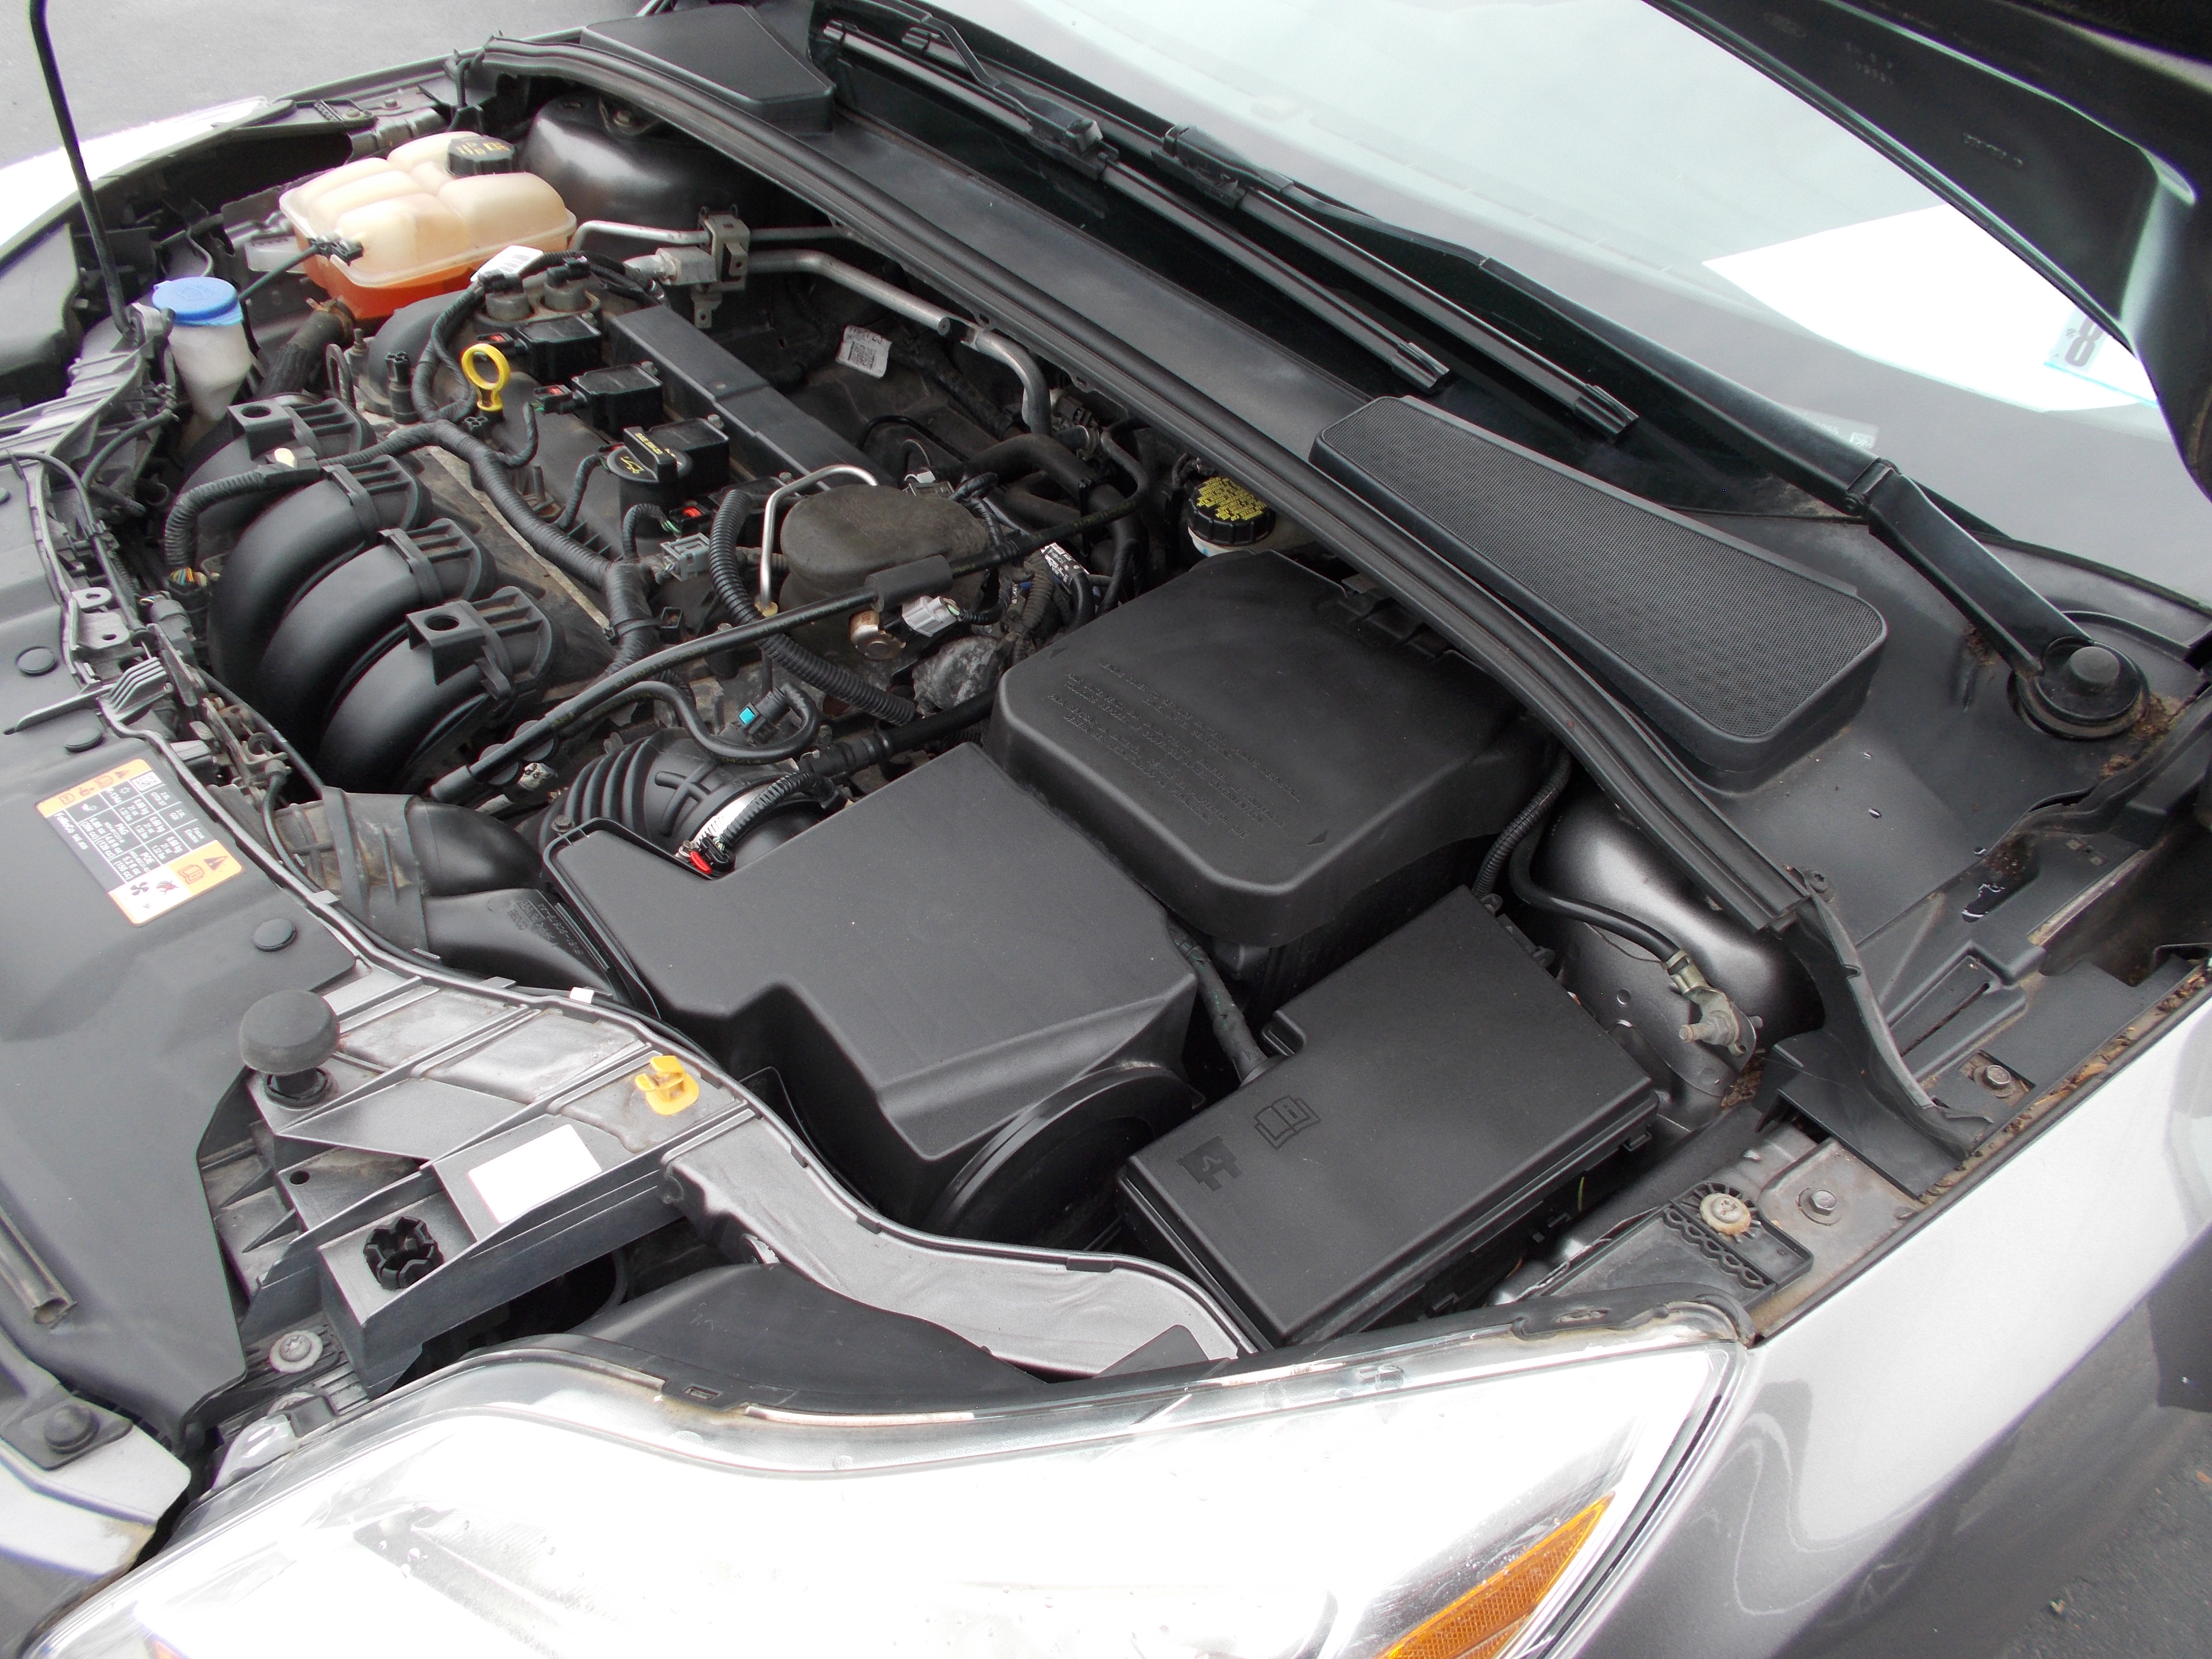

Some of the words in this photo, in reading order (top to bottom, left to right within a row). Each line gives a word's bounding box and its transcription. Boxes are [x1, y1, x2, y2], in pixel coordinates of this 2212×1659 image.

[2064, 316, 2104, 367] 8
[1125, 675, 1150, 693] COVER
[132, 798, 147, 809] 0.60
[118, 806, 129, 816] 1.32
[123, 813, 134, 821] lbs
[138, 806, 152, 816] kg
[53, 811, 77, 834] FoMoCo
[71, 833, 83, 842] SAE
[148, 815, 163, 827] 0.60
[79, 820, 94, 833] (200
[87, 830, 100, 841] cc)
[114, 822, 130, 835] PAG
[133, 824, 145, 834] 1.32
[154, 824, 168, 833] kg
[192, 826, 207, 839] Focus
[165, 835, 180, 847] 0.60
[95, 839, 110, 852] (120
[103, 849, 117, 859] cc)
[113, 846, 123, 854] oz
[150, 844, 163, 854] 1.32
[157, 852, 168, 860] lbs
[171, 844, 185, 854] kg
[139, 851, 156, 865] POE
[112, 859, 129, 873] (155
[121, 870, 134, 880] cc)
[121, 855, 134, 865] 5.2
[131, 867, 141, 875] oz
